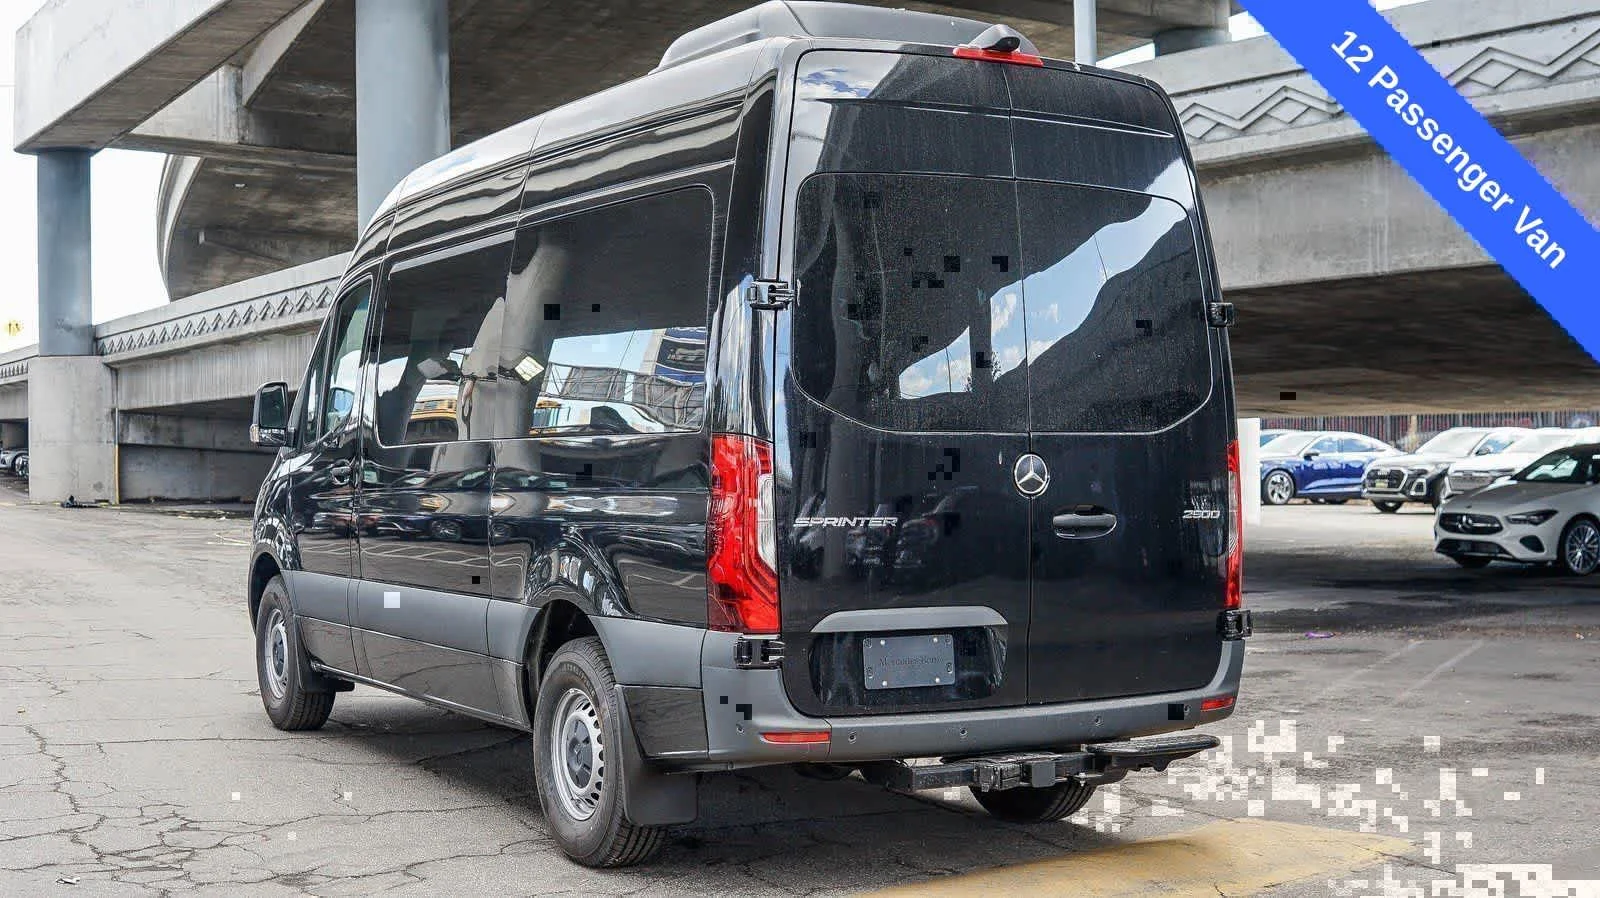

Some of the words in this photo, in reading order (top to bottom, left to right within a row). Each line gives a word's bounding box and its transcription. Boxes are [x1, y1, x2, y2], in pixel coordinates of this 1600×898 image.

[1182, 509, 1221, 519] 2500
[792, 516, 899, 528] SPRINTER
[878, 655, 944, 667] Mcedes-Ben
